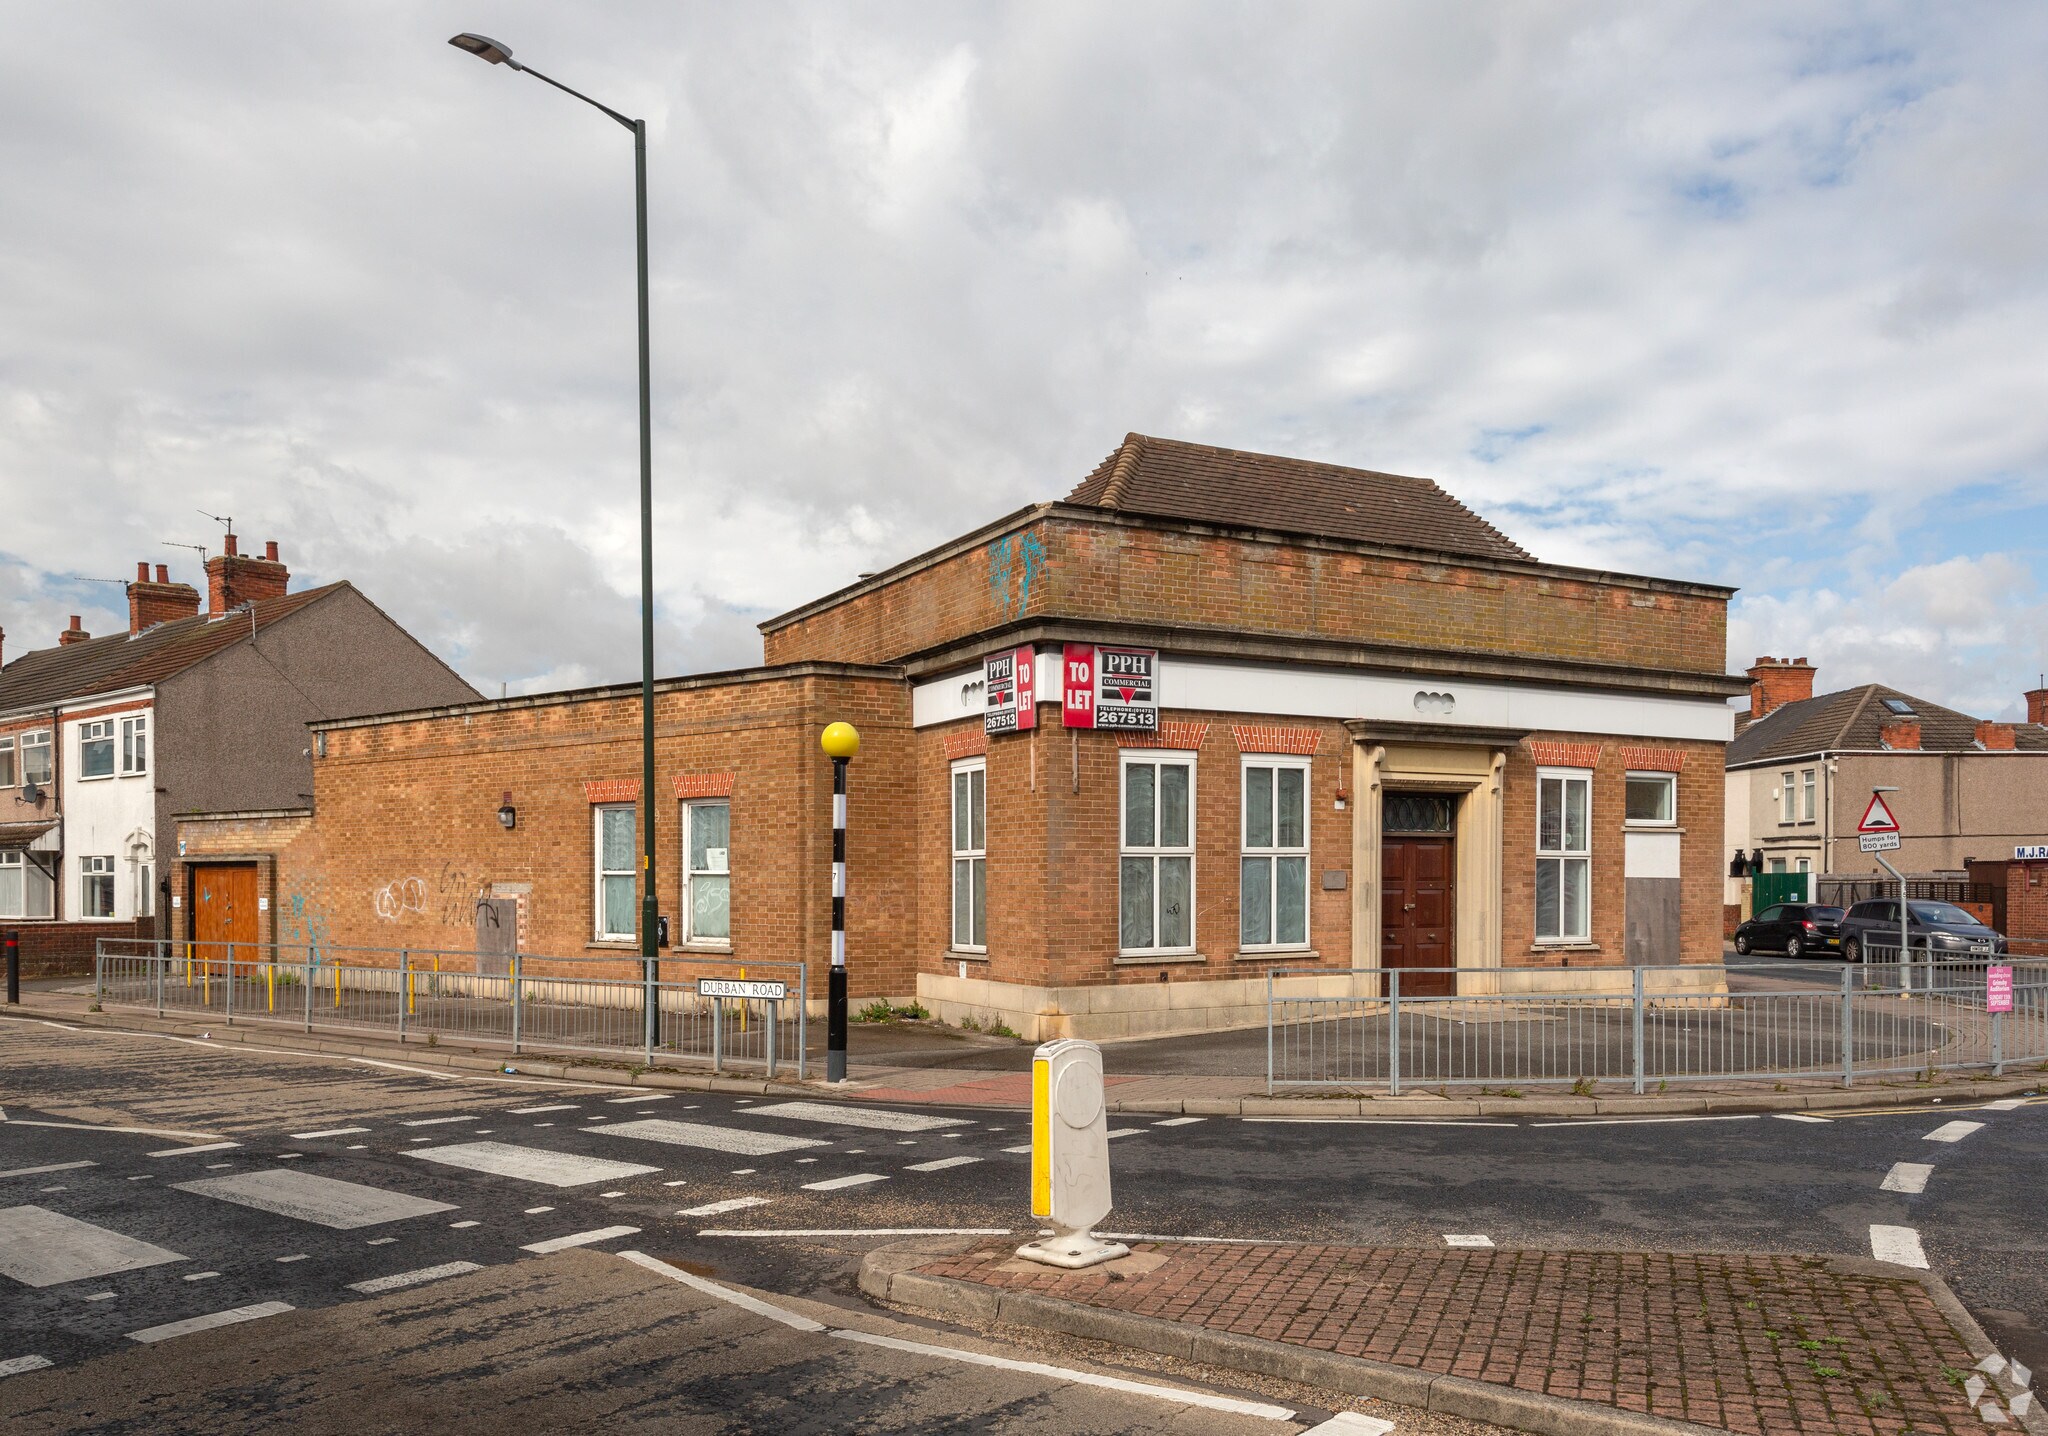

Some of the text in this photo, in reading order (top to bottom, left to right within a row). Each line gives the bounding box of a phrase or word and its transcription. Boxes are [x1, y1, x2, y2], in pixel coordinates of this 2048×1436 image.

[990, 658, 1010, 679] PPH
[1019, 664, 1030, 684] TO
[1069, 662, 1089, 682] TO
[1107, 654, 1146, 674] PPH
[1104, 678, 1149, 687] COMMERCIAL
[1019, 690, 1031, 711] LET
[1067, 689, 1091, 710] LET
[986, 714, 1015, 728] 267513
[1098, 712, 1154, 724] 267513
[704, 982, 782, 996] DURBAN ROAD
